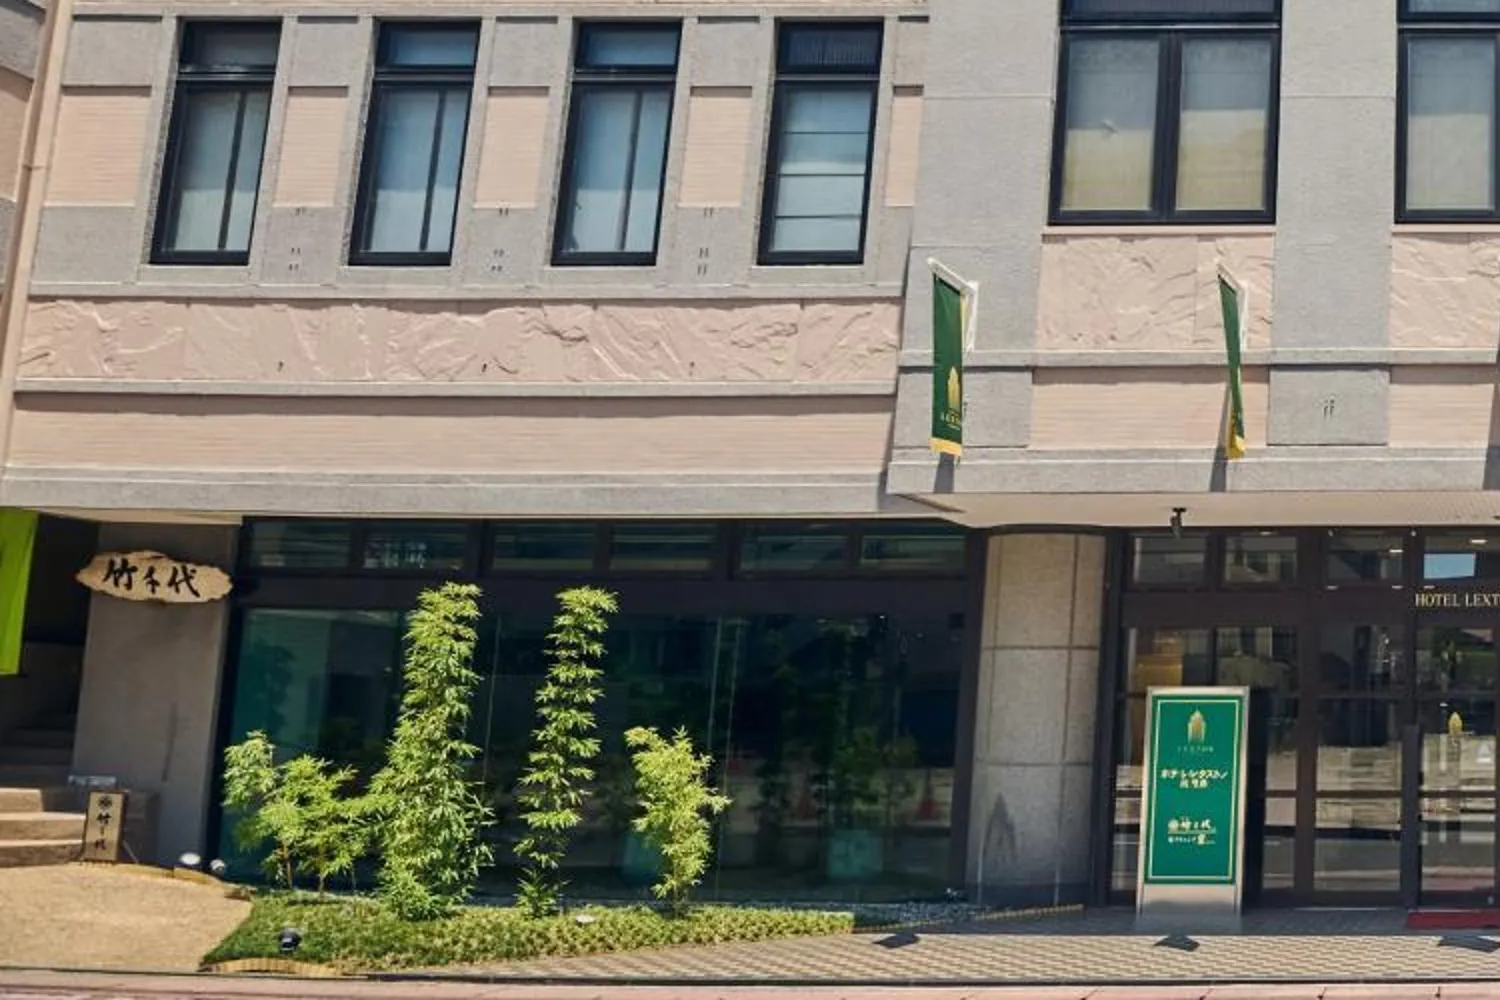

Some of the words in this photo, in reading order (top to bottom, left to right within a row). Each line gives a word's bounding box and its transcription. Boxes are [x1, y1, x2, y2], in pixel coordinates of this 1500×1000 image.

[102, 557, 201, 598] 竹千代
[1415, 592, 1461, 608] HOTEL
